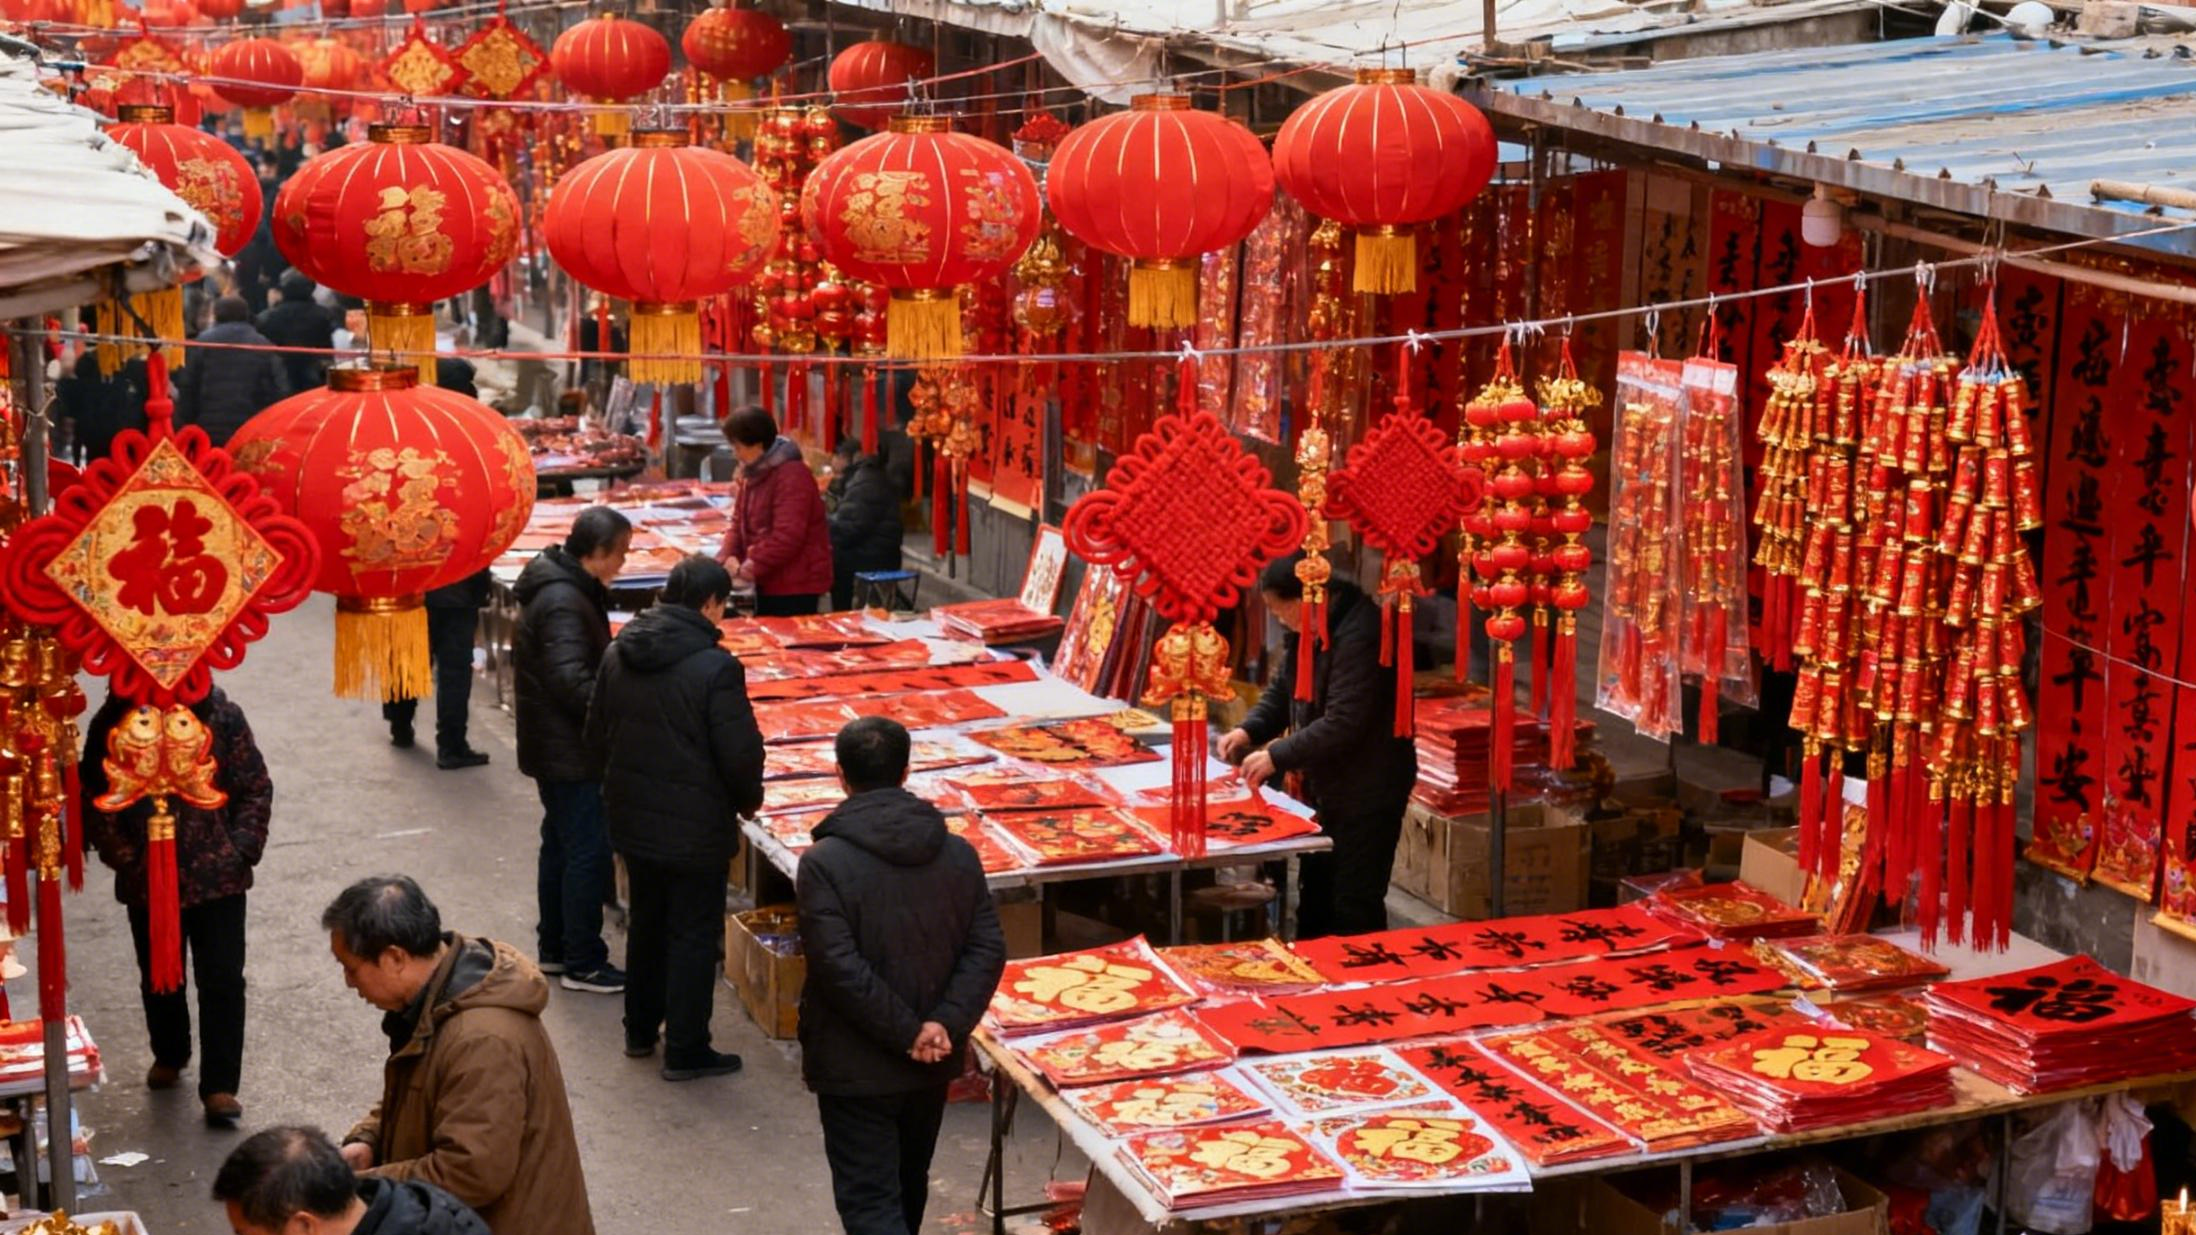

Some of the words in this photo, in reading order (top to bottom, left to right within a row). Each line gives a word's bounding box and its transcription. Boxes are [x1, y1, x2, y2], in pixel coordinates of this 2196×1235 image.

[107, 496, 228, 616] 福
[1013, 954, 1153, 1014] 福
[1984, 976, 2119, 1023] 福
[1752, 1035, 1873, 1084] 福
[1189, 1130, 1303, 1178] 福
[1352, 1119, 1464, 1165] 福
